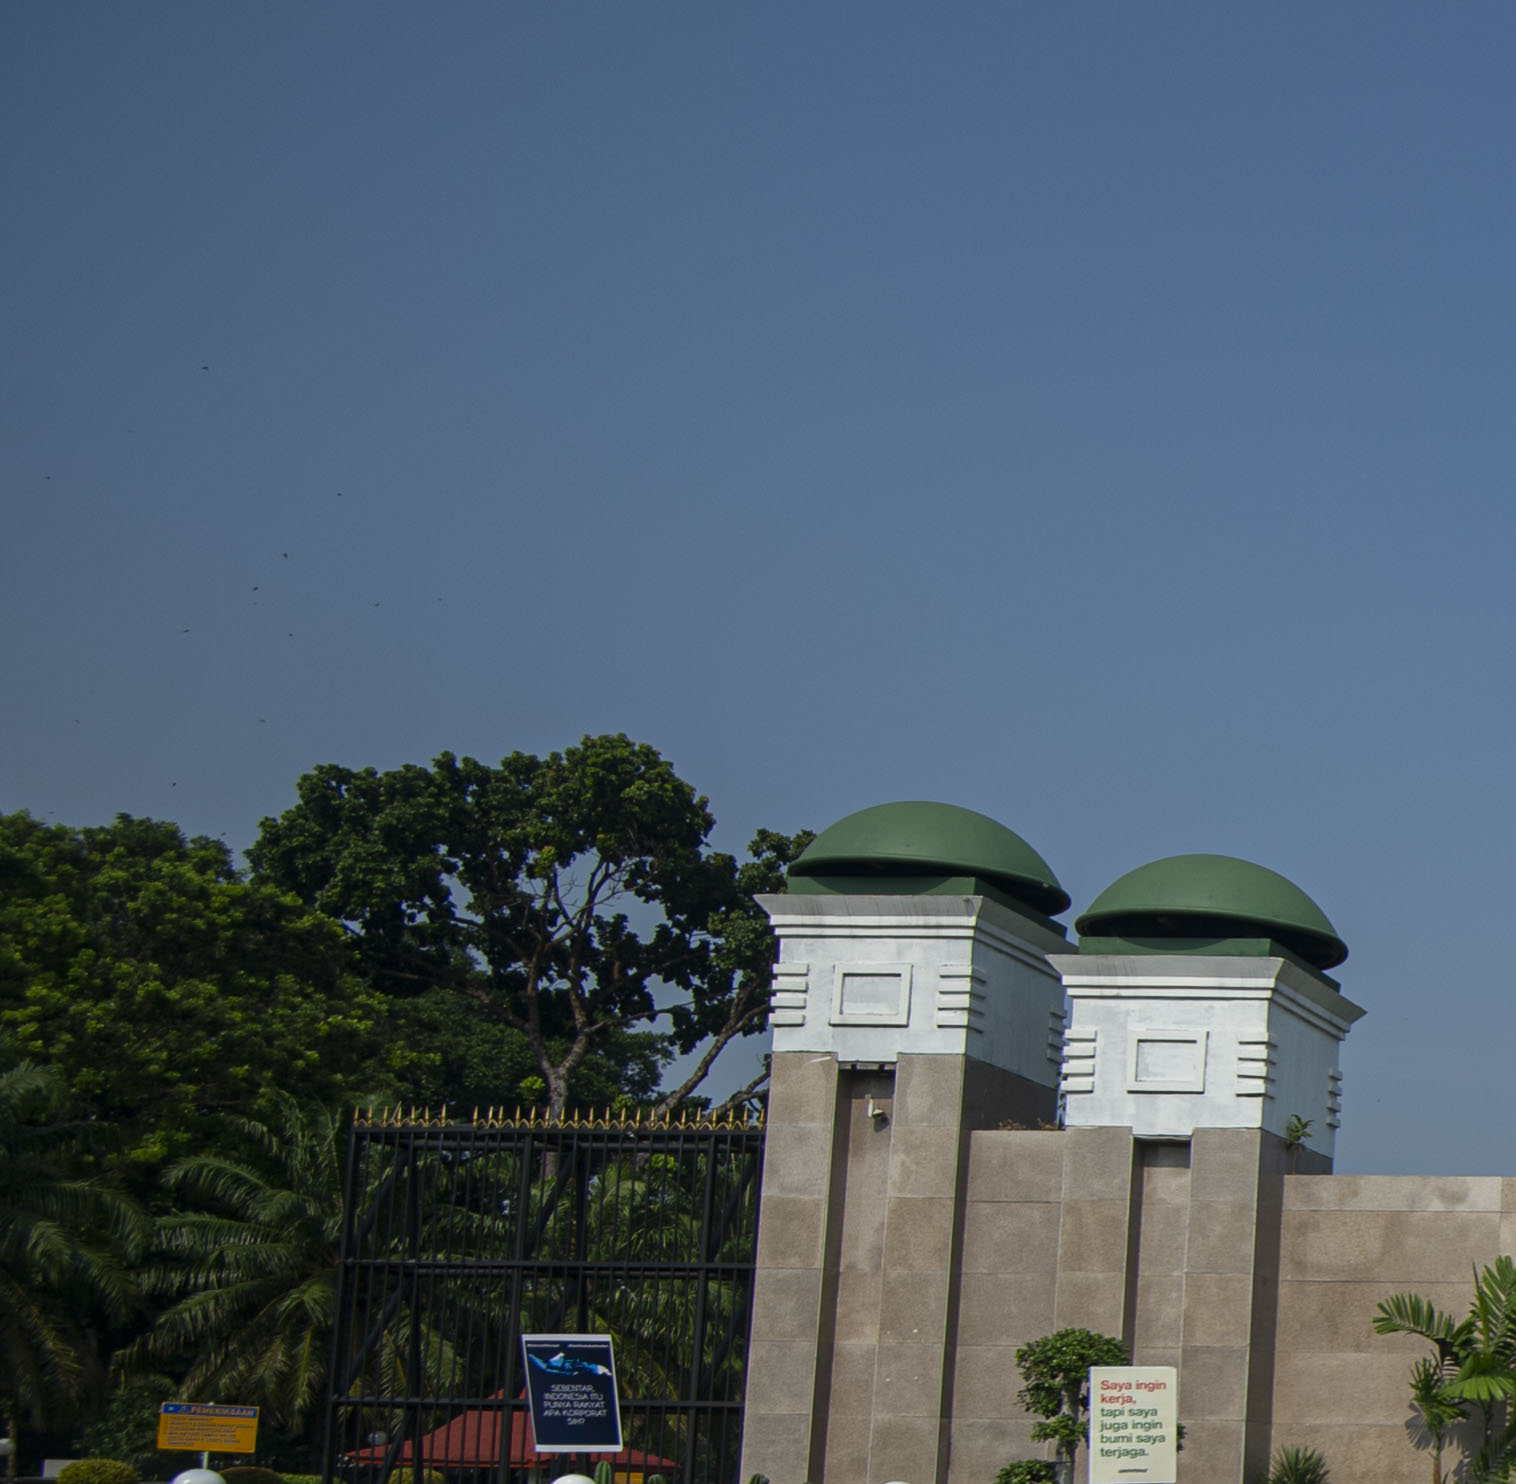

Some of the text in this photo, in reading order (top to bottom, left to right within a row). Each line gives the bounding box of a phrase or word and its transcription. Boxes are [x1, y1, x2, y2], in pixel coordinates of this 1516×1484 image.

[1100, 1380, 1167, 1392] Saya ingin
[544, 1392, 604, 1401] INDONESIA ITU
[1100, 1393, 1136, 1405] kerja,
[544, 1401, 606, 1409] PUNYA RAKYAT
[544, 1409, 608, 1417] APA KORPORAT
[1100, 1407, 1158, 1418] tapi saya
[1100, 1420, 1162, 1432] juga ingin
[1100, 1433, 1166, 1445] bumi saya
[1100, 1447, 1149, 1459] terjaga.
